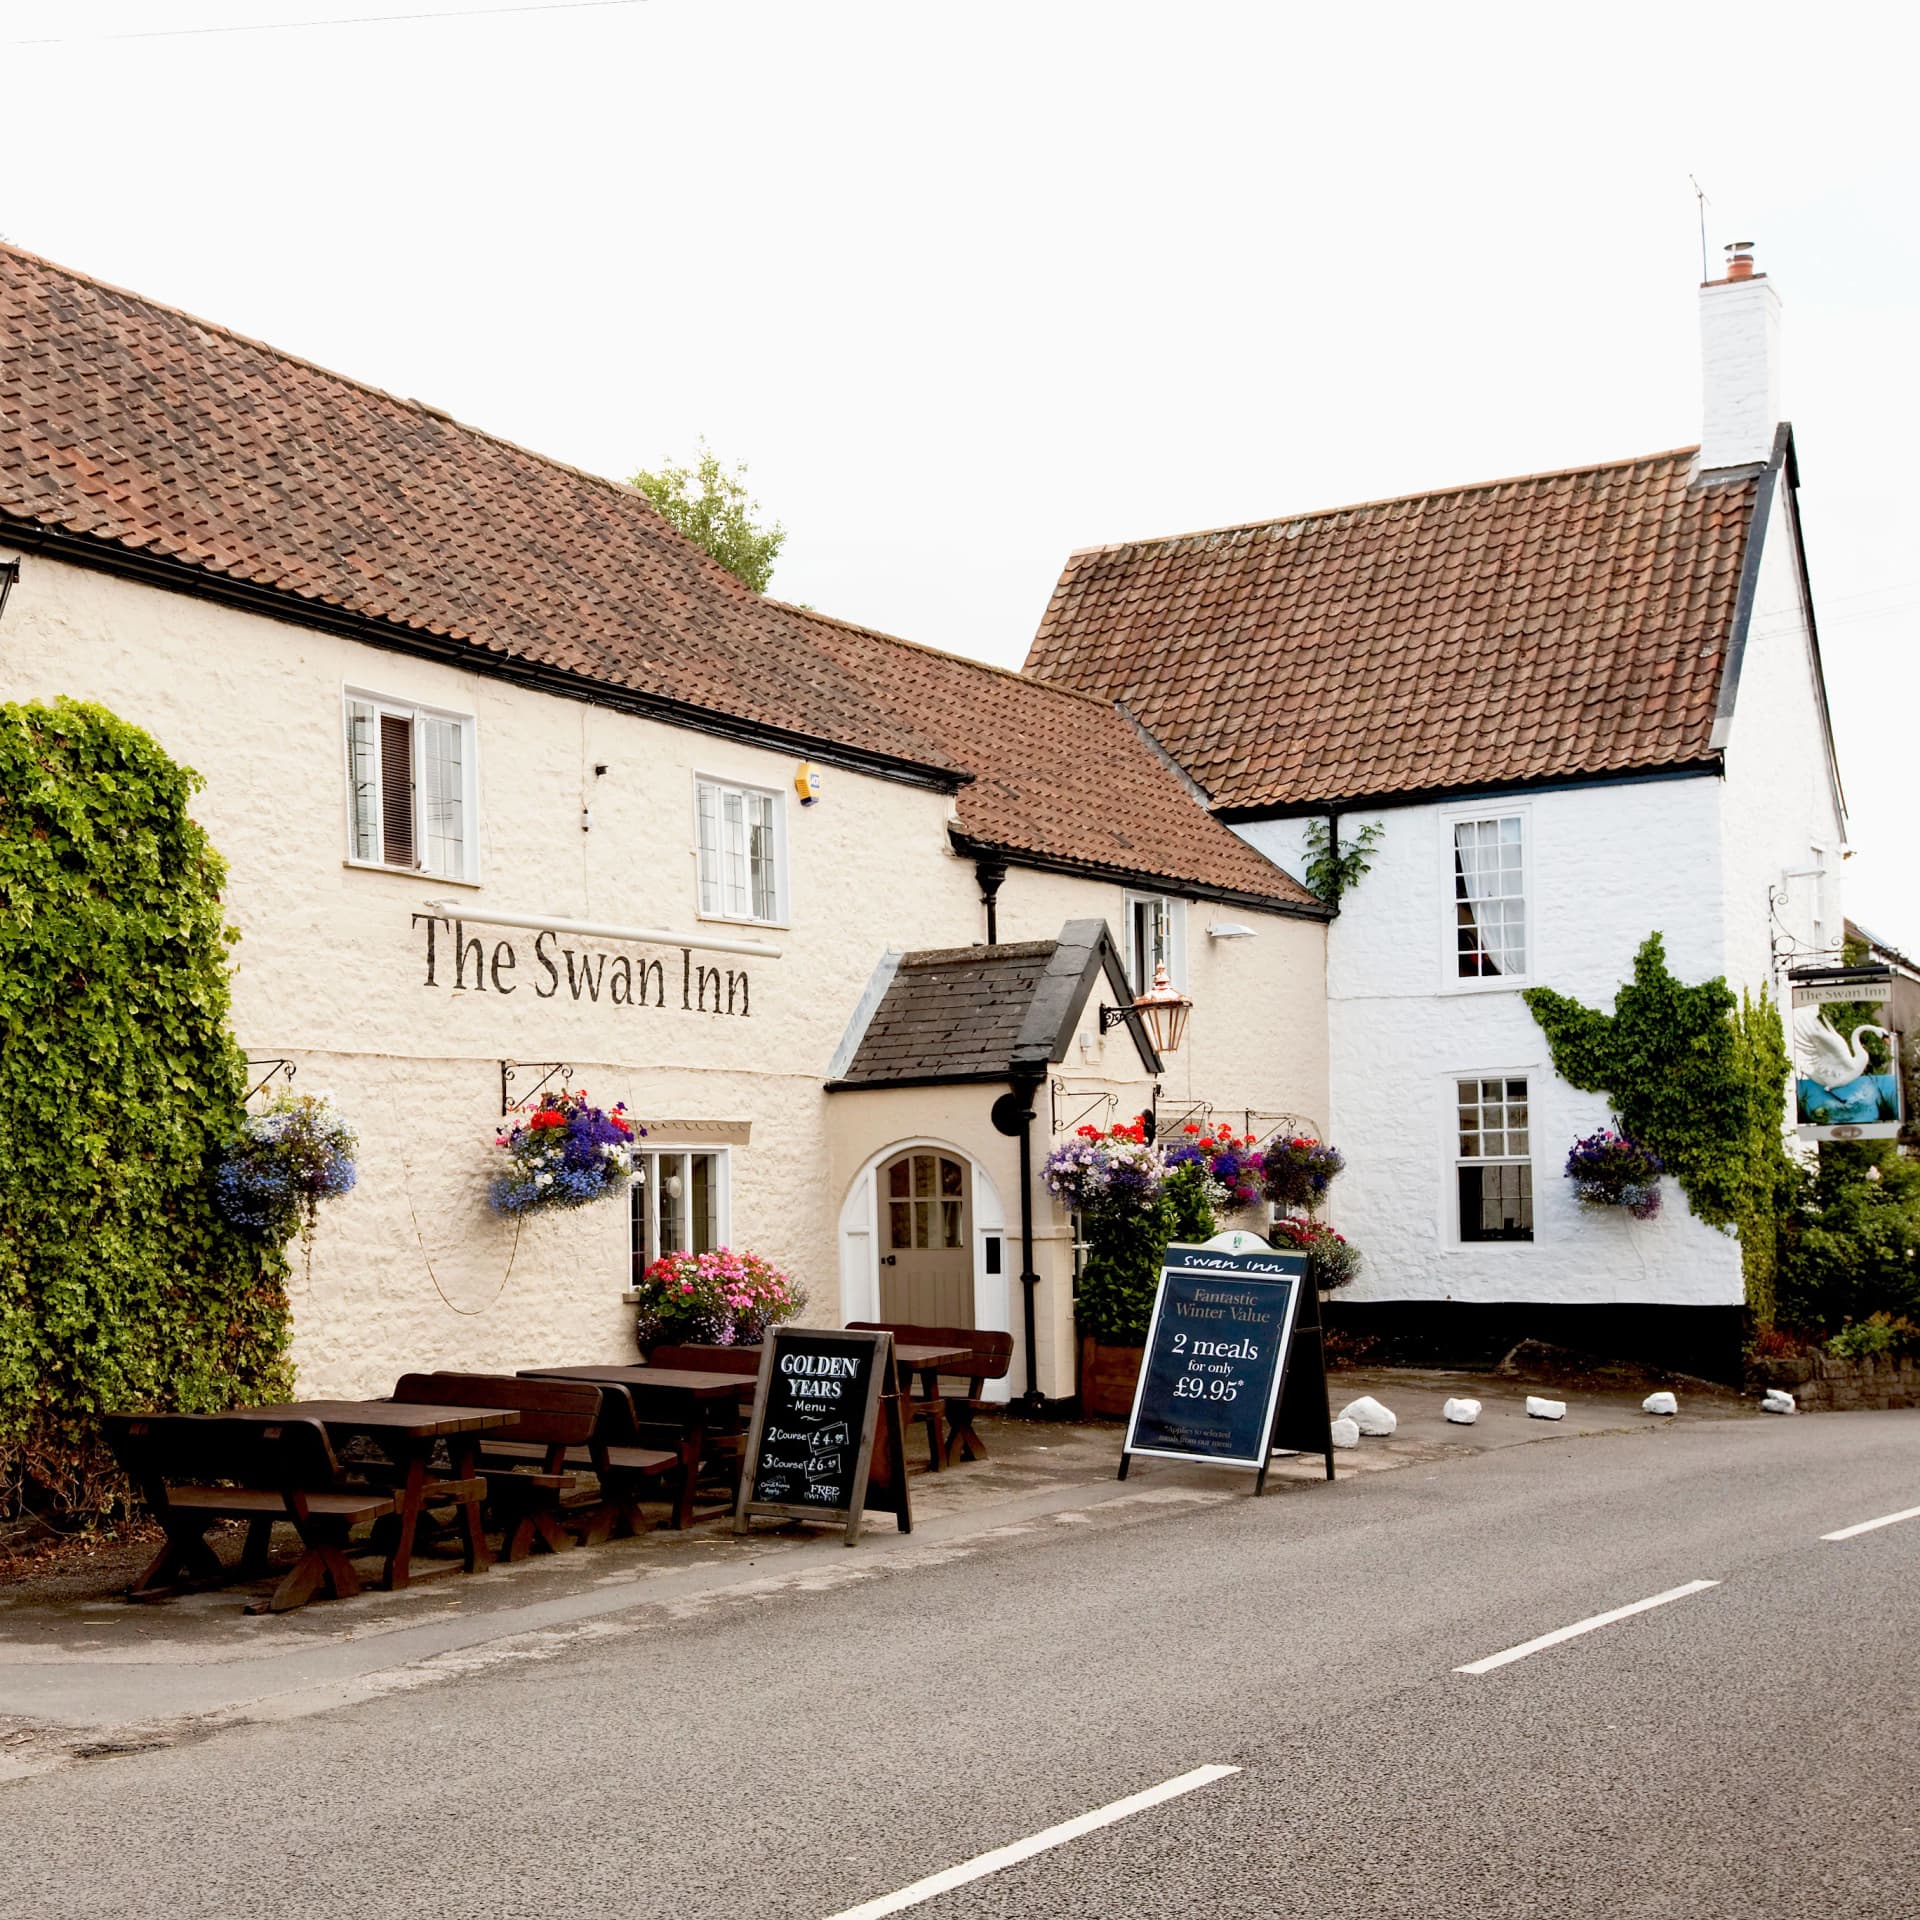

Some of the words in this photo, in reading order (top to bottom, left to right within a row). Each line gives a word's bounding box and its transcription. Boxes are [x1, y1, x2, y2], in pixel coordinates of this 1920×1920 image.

[412, 912, 517, 995] The
[535, 931, 665, 1008] Swan
[681, 948, 751, 1017] Inn
[1799, 990, 1822, 1001] The
[1825, 988, 1861, 999] Swan
[1864, 986, 1887, 997] Inn
[1193, 1288, 1259, 1306] Fantastic
[1176, 1302, 1226, 1319] Winter
[1230, 1306, 1270, 1323] Value
[1171, 1333, 1188, 1355] 2
[1191, 1338, 1259, 1360] meals
[780, 1353, 860, 1379] GOLDEN
[1188, 1359, 1206, 1372] for
[1207, 1362, 1234, 1377] only
[787, 1378, 843, 1399] YEARS
[767, 1426, 777, 1442] 2
[776, 1428, 807, 1441] Course
[762, 1453, 773, 1469] 3
[773, 1457, 804, 1470] Course
[810, 1484, 841, 1496] FREE
